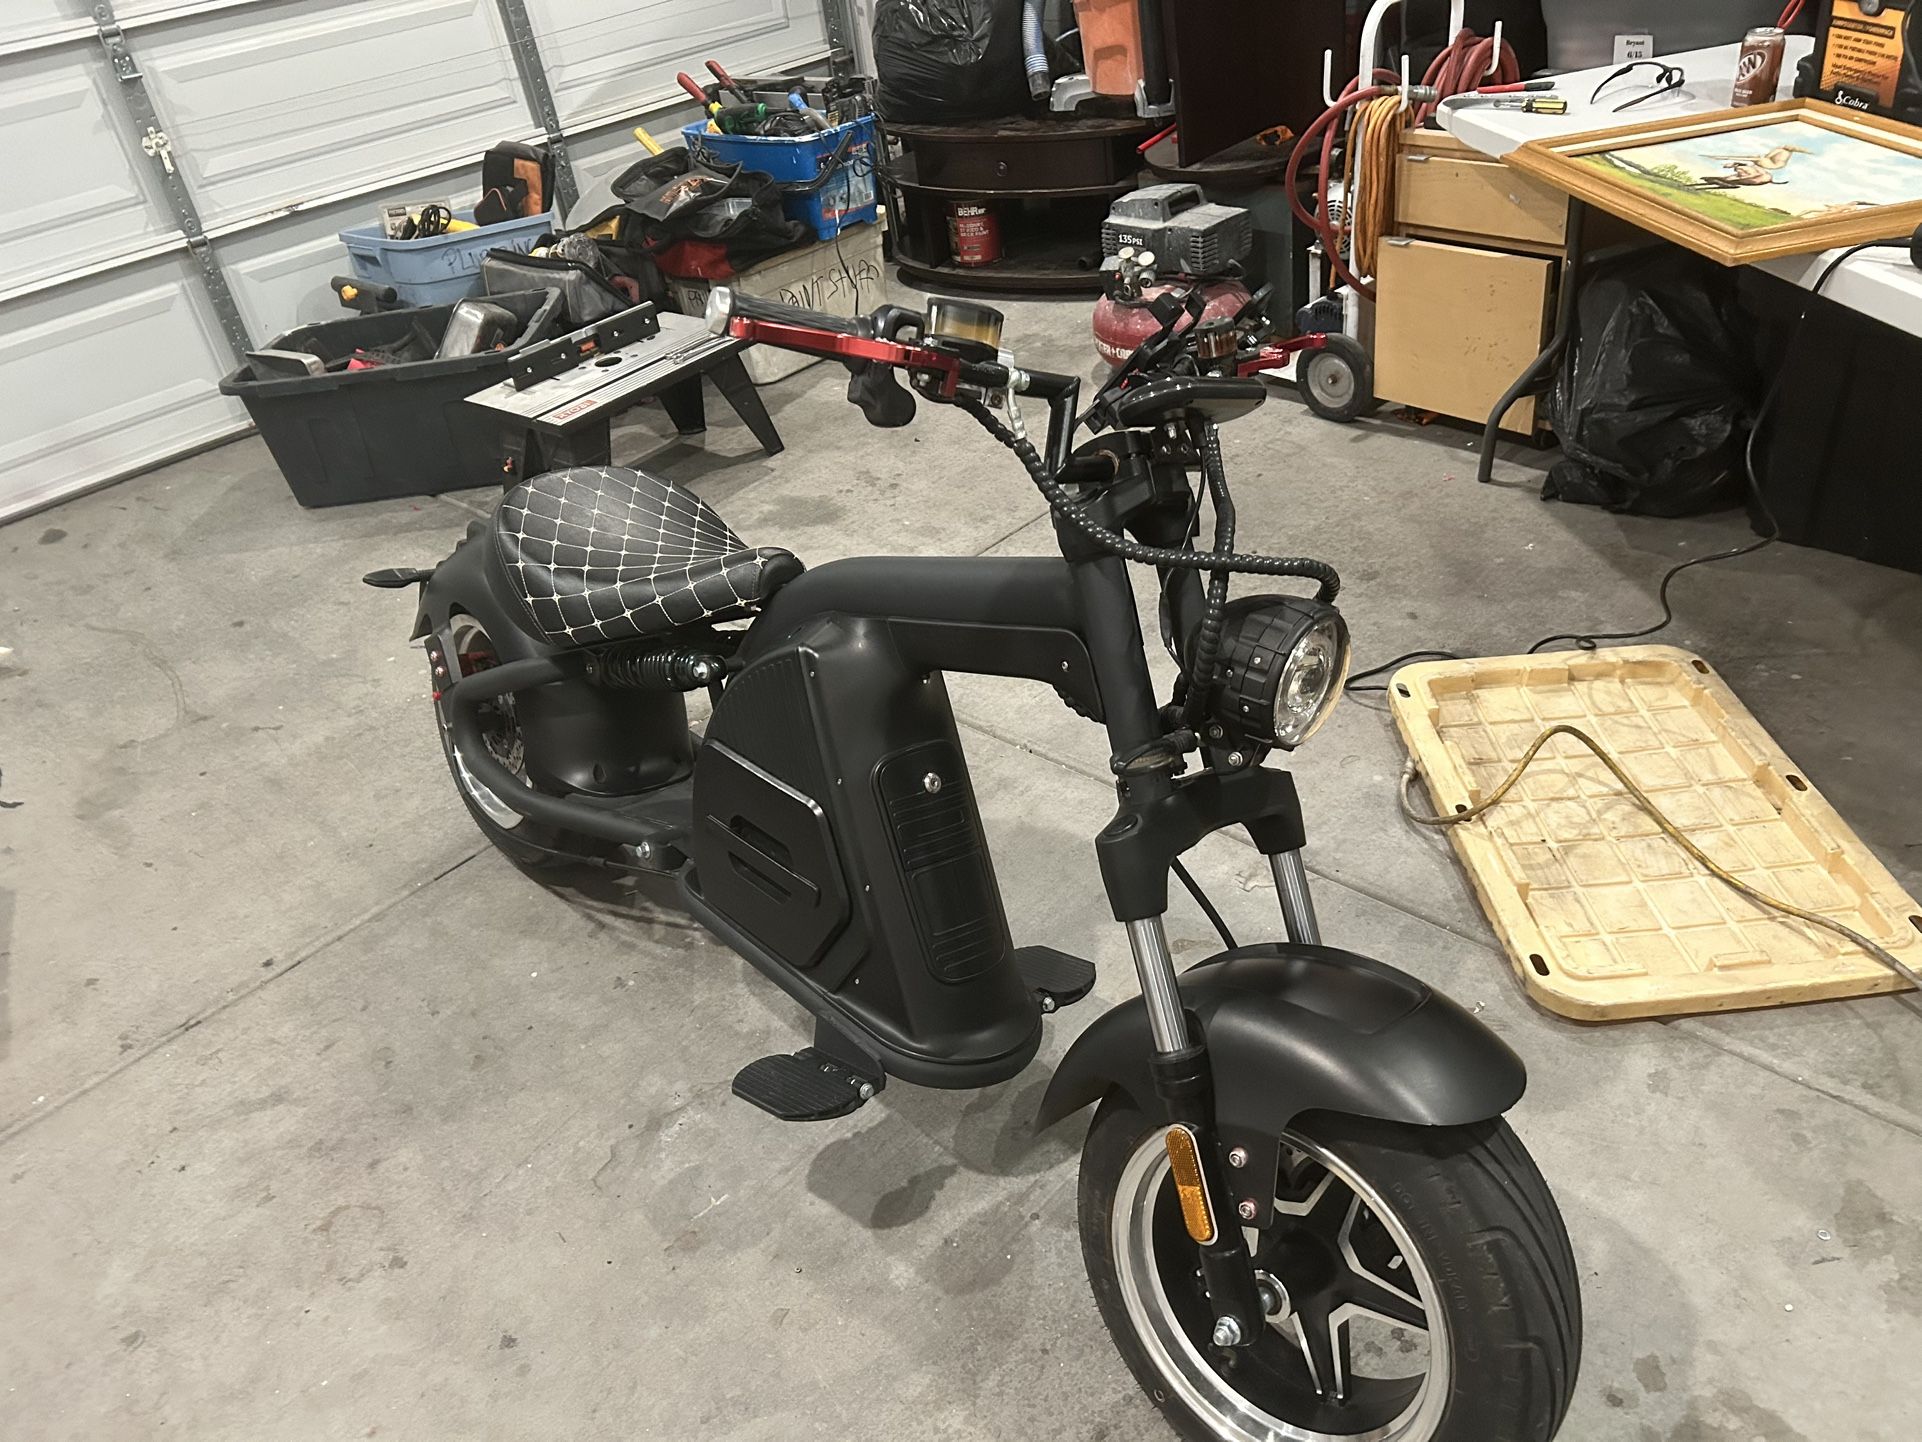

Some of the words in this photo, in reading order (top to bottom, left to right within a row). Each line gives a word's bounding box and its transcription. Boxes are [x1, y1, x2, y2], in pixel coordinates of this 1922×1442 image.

[1842, 96, 1869, 110] Cobra
[957, 206, 979, 217] BEHR
[1118, 234, 1133, 243] 135
[1132, 237, 1143, 246] PSI
